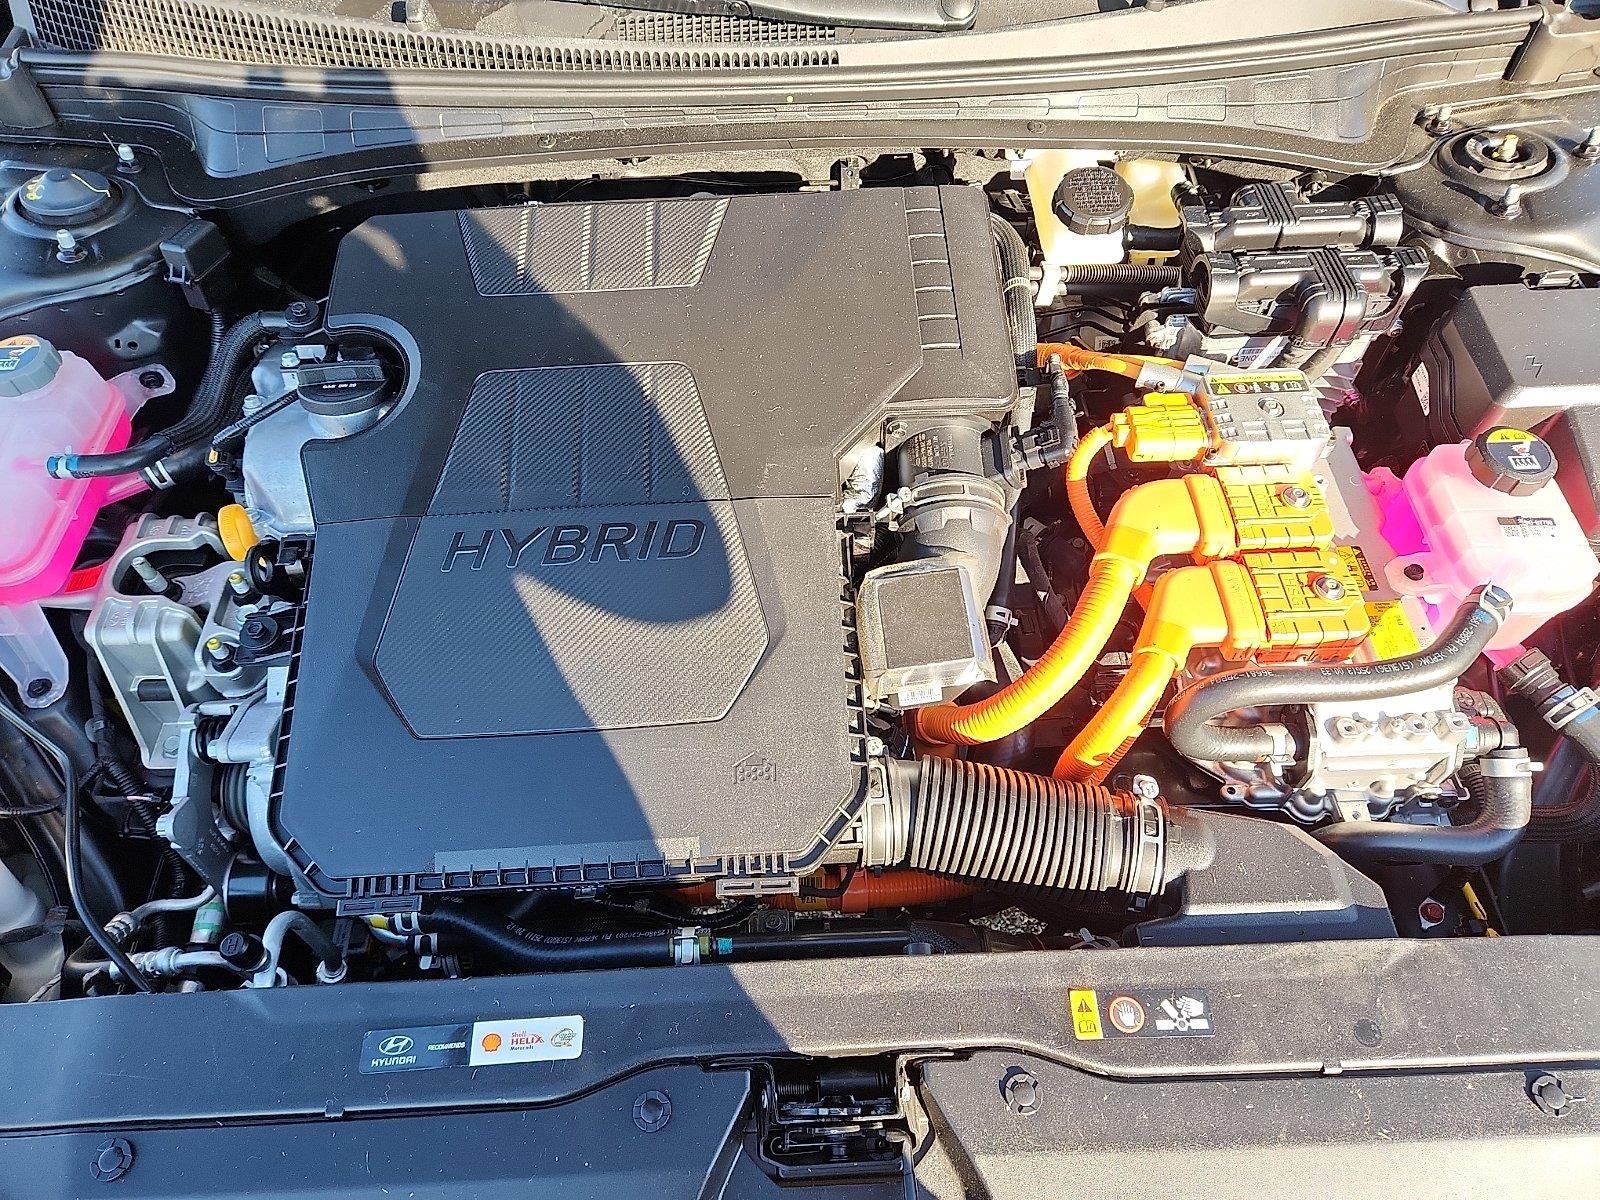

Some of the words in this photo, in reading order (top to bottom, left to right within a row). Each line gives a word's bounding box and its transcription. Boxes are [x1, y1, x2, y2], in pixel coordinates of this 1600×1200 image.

[440, 518, 707, 573] HYBRID
[226, 937, 239, 952] H
[511, 1030, 527, 1038] Shell
[427, 1041, 466, 1051] RECOMMENDS
[510, 1035, 544, 1046] HELIX
[371, 1055, 417, 1068] HYUNDAI
